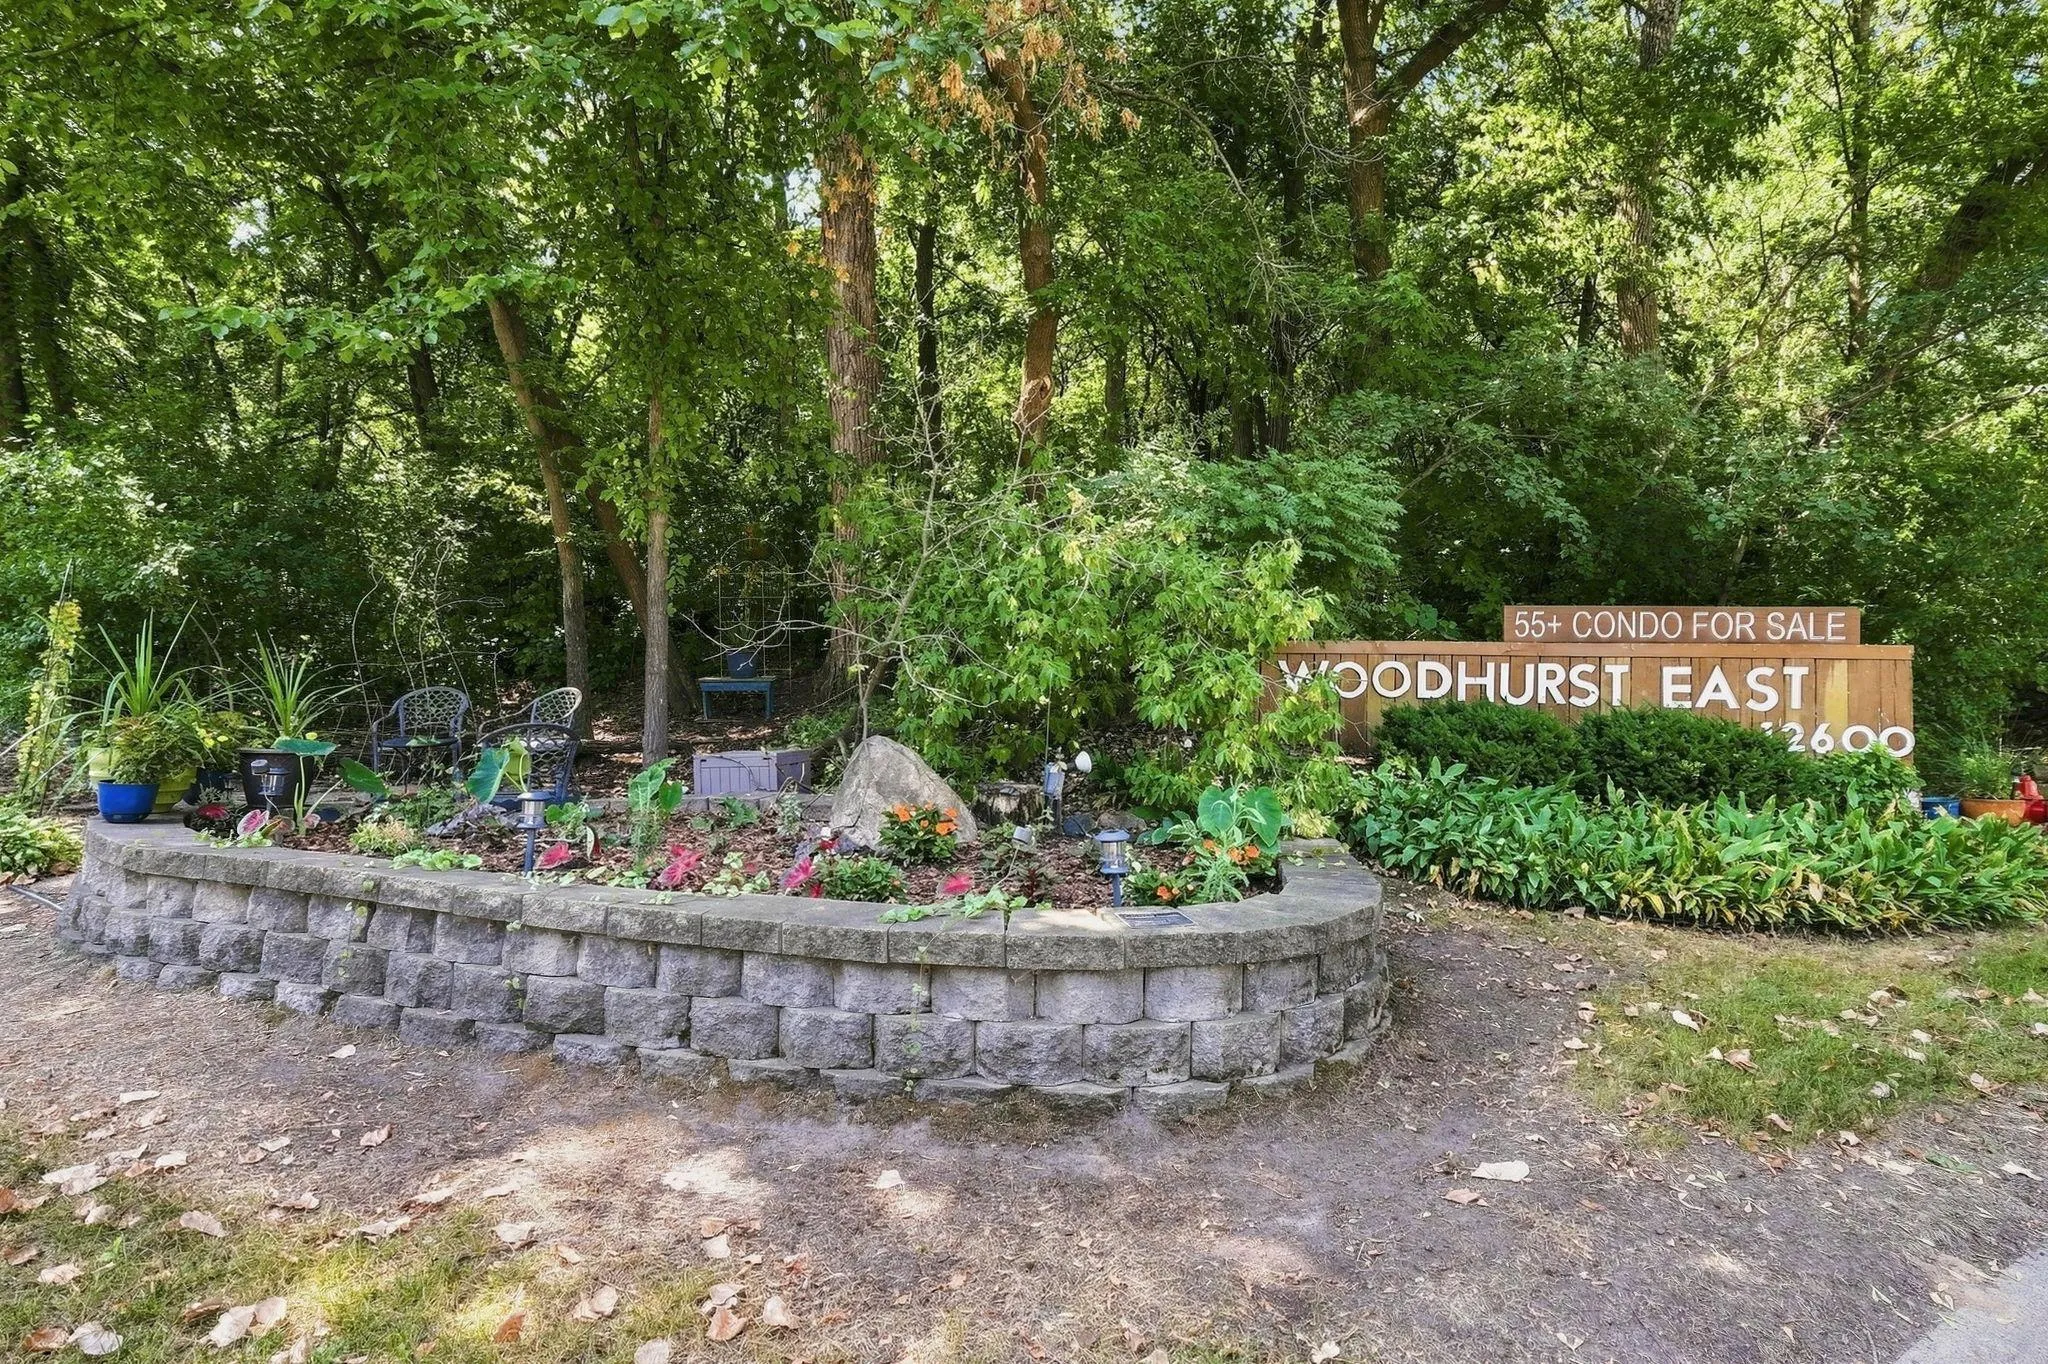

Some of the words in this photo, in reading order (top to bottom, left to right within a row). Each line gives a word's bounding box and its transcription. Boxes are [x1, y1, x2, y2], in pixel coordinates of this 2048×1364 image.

[1514, 611, 1562, 638] 55+
[1572, 611, 1683, 639] CONDO
[1691, 611, 1756, 640] FOR
[1766, 611, 1847, 641] SALE
[1278, 659, 1630, 708] WOODHURST
[1661, 664, 1810, 712] EAST
